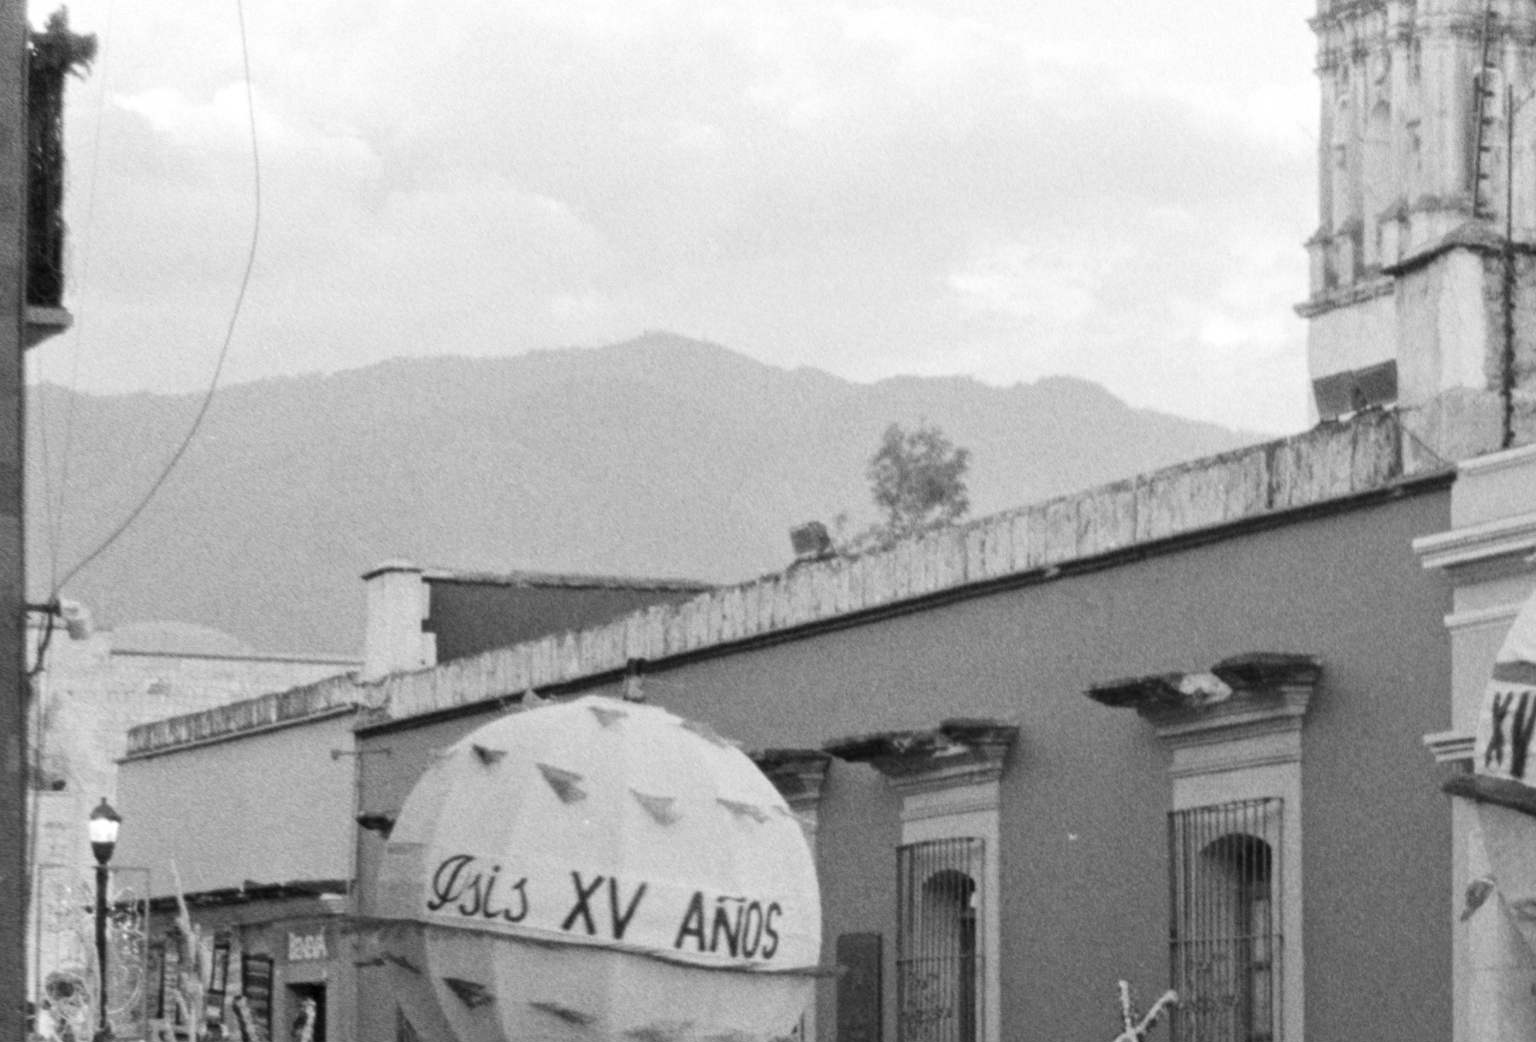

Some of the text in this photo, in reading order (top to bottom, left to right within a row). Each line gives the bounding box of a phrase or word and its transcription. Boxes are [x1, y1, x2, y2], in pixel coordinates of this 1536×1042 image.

[427, 854, 782, 960] Isis XV AÑOS
